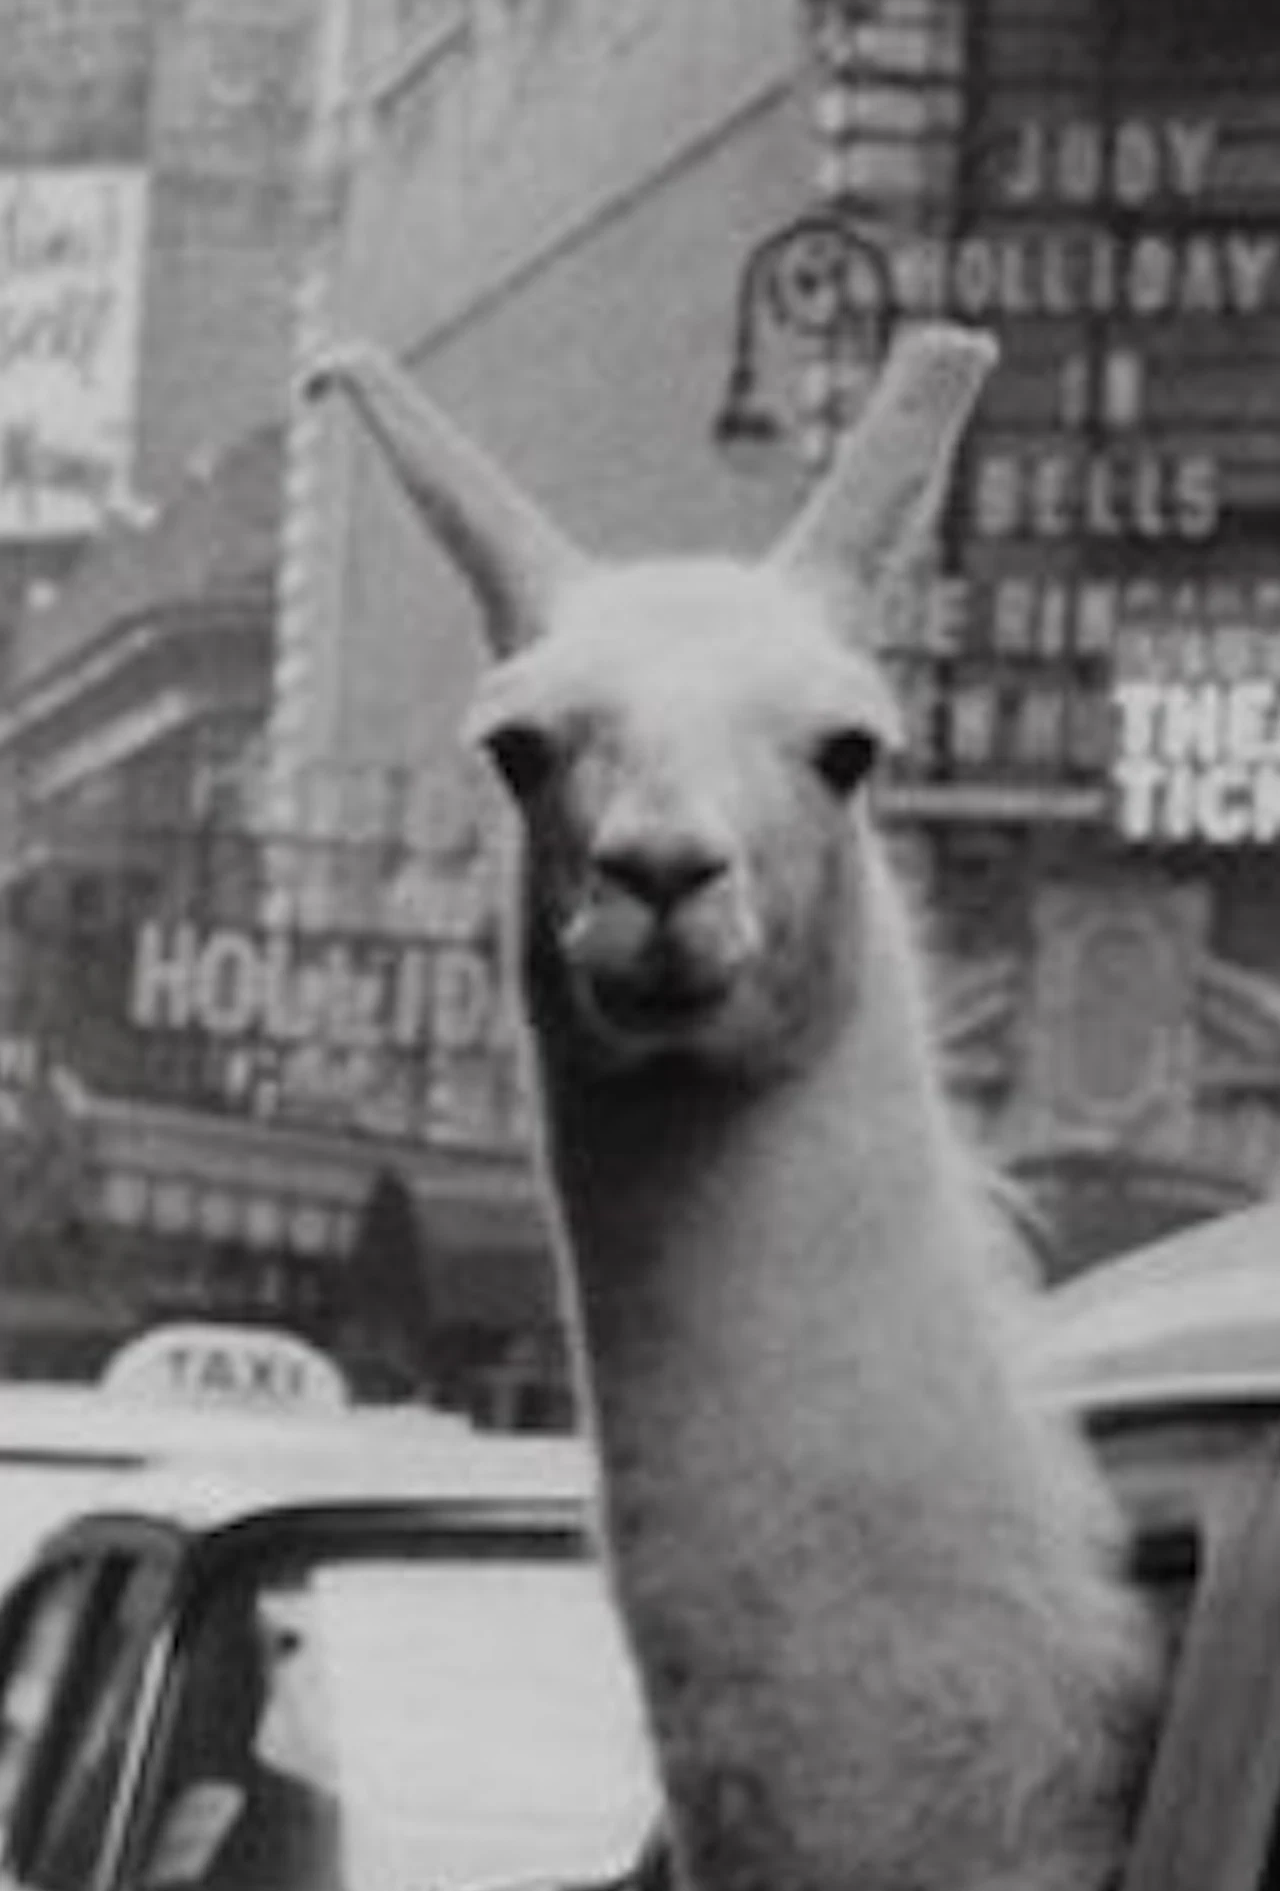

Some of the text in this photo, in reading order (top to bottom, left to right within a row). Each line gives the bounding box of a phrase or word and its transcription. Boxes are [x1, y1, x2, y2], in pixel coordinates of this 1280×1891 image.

[1004, 116, 1220, 204] JUDY
[976, 452, 1220, 540] BELLS
[168, 1346, 308, 1404] TAXI
